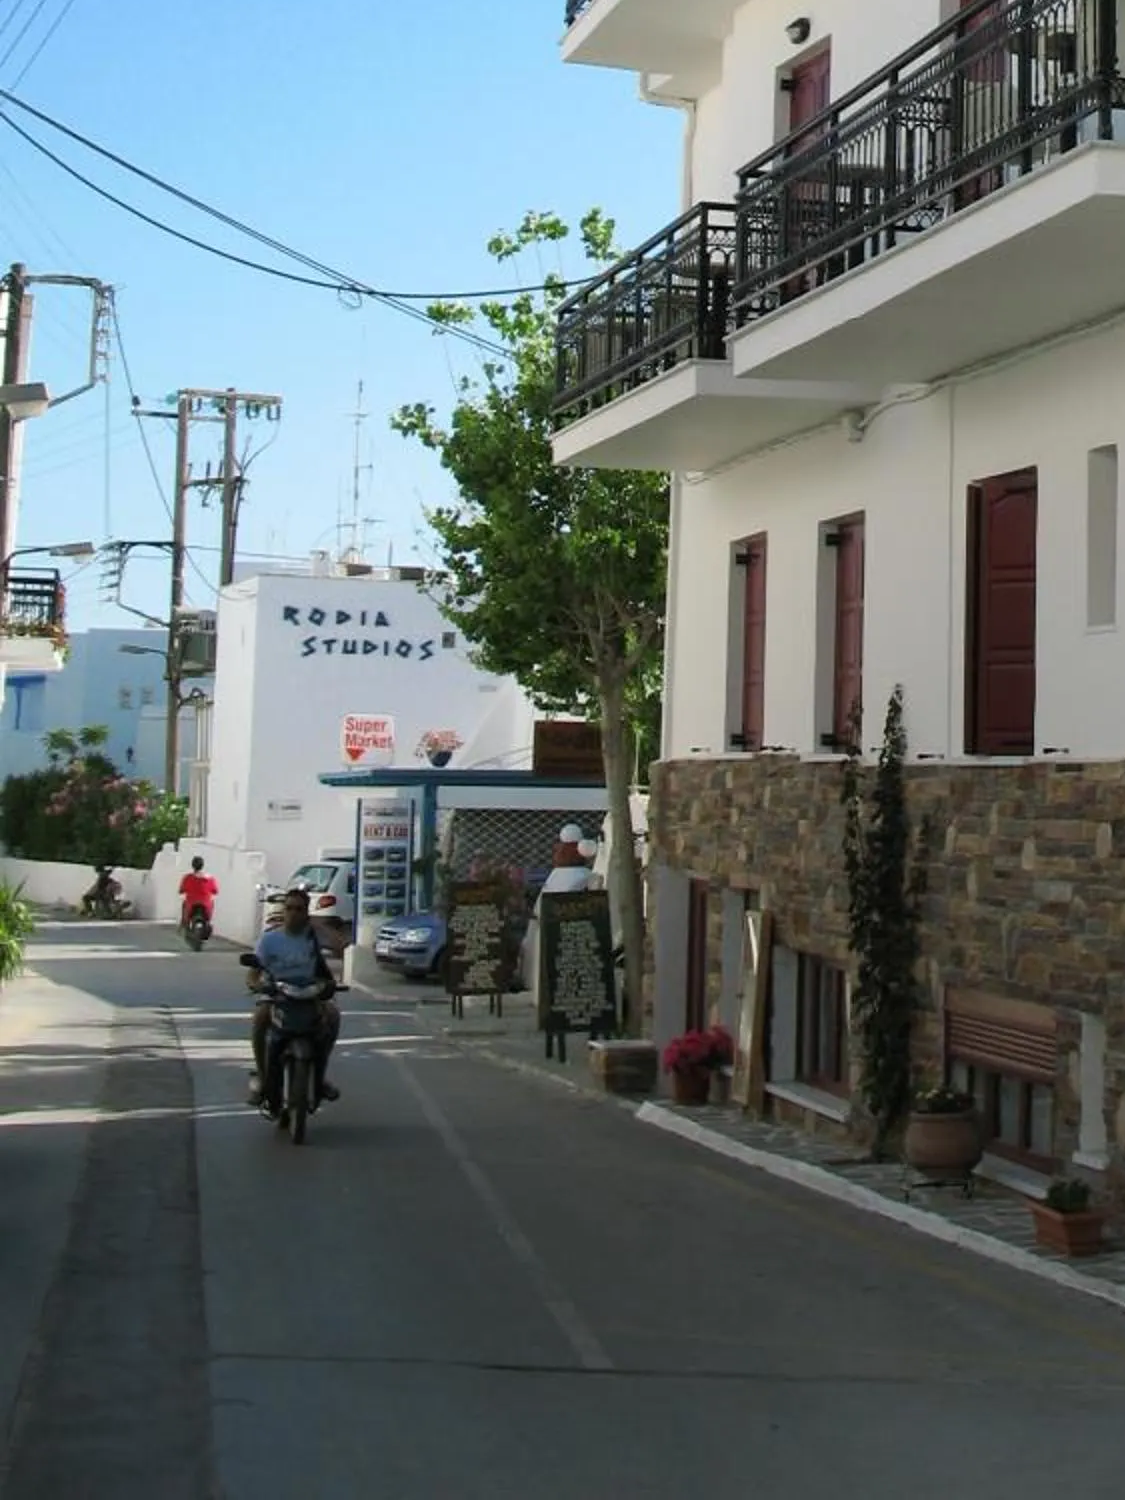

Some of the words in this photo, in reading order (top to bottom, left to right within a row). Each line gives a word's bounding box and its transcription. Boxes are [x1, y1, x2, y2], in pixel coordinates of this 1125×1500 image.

[282, 605, 390, 627] RODIA
[301, 635, 434, 661] STUDIOS
[345, 716, 386, 734] Super
[345, 734, 393, 749] Market
